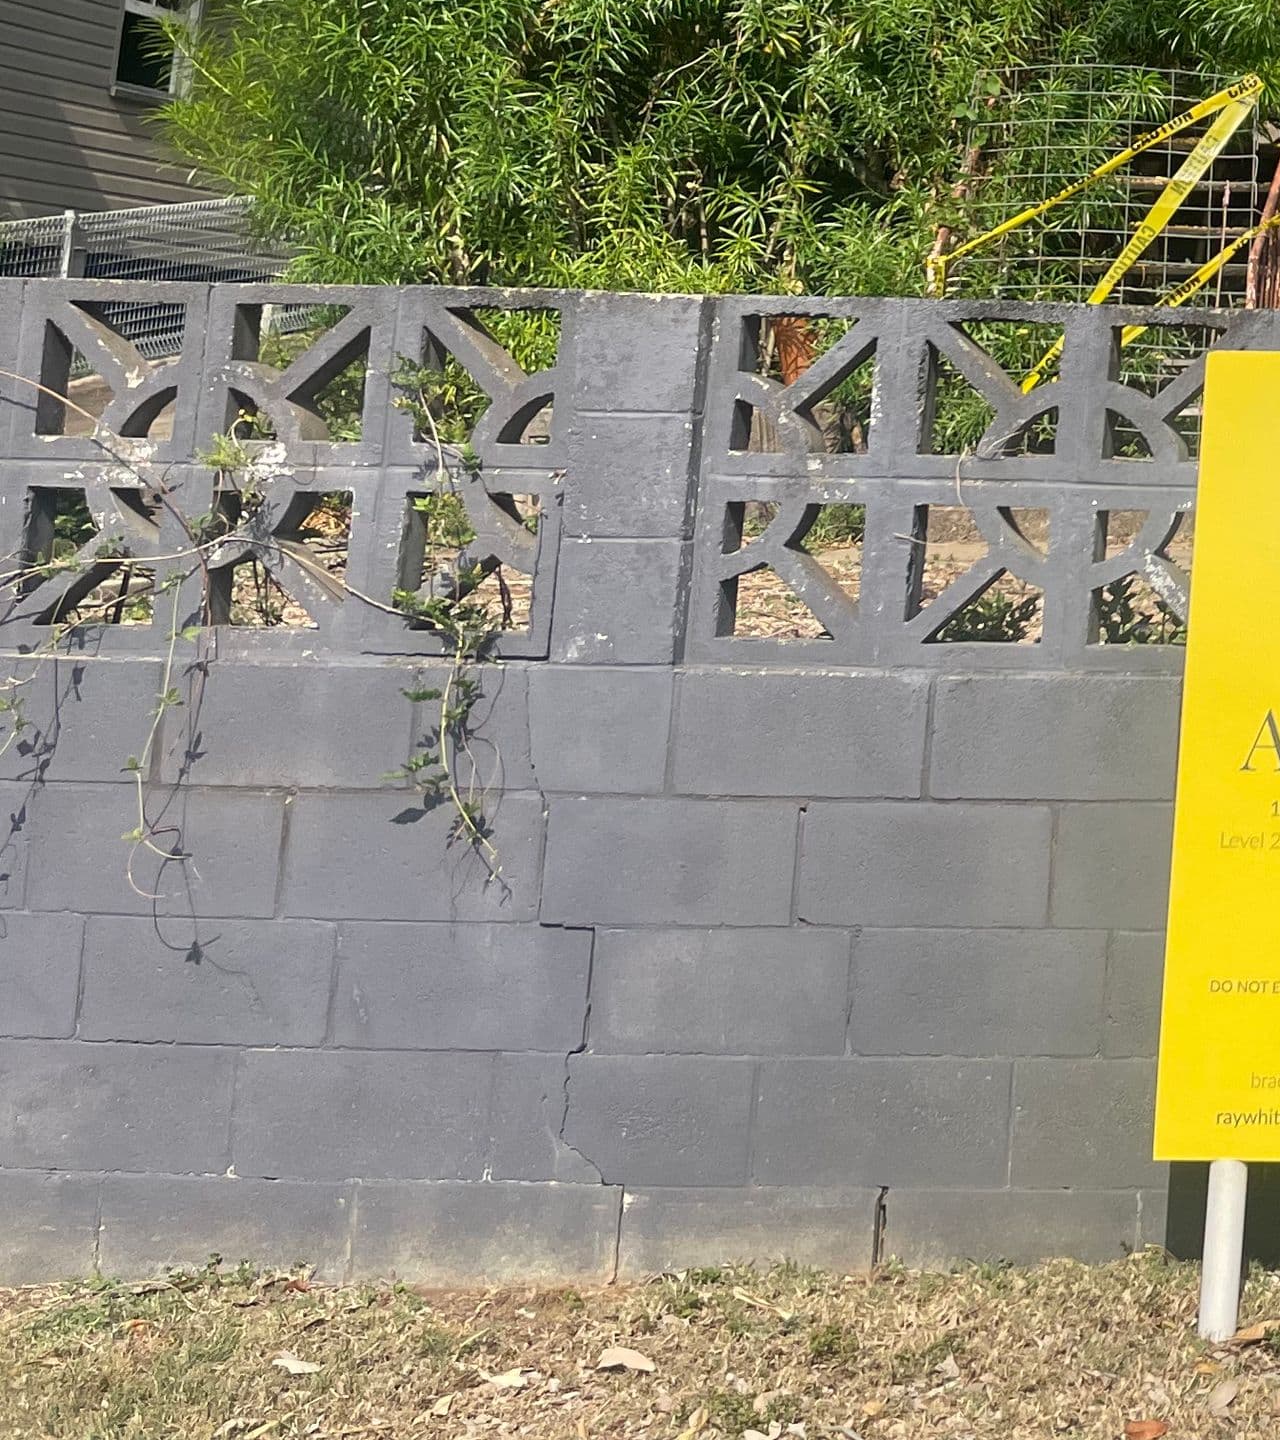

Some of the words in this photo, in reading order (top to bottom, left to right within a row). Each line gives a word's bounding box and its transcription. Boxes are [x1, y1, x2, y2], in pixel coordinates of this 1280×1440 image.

[1131, 111, 1194, 152] CAUTION
[1220, 831, 1265, 849] Level
[1209, 979, 1233, 993] DO
[1237, 980, 1269, 994] NOT
